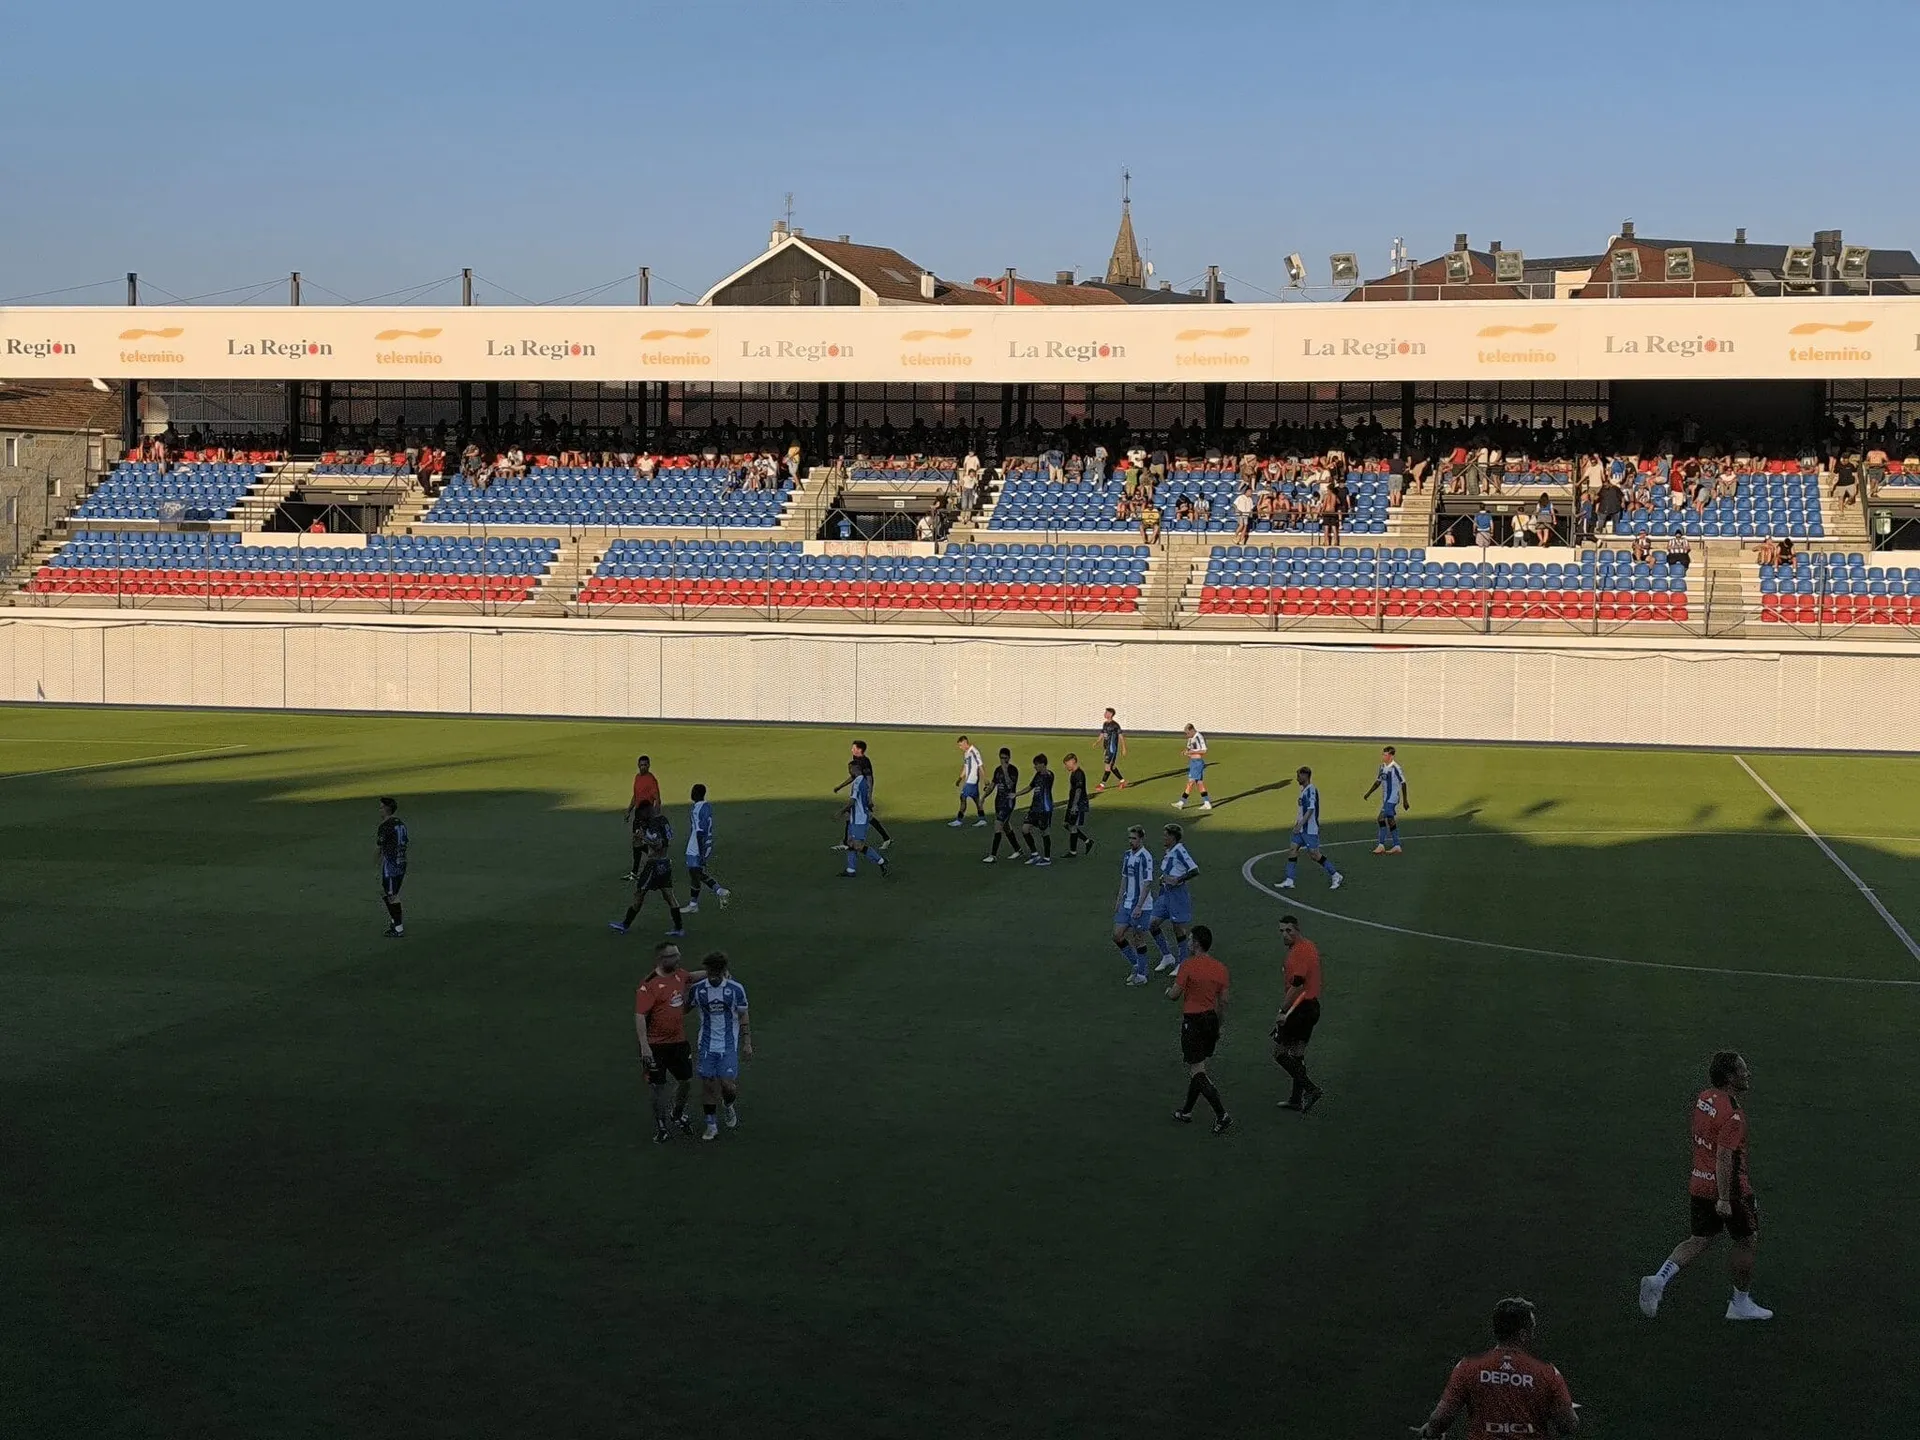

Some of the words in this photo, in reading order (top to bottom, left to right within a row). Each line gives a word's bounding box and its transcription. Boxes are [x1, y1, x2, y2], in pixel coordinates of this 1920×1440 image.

[6, 338, 76, 359] Región
[119, 347, 185, 364] telemiño
[227, 338, 255, 356] La
[260, 338, 333, 360] Región
[486, 339, 516, 357] La
[521, 339, 596, 361] Región
[741, 340, 772, 359] La
[776, 340, 854, 362] Región
[1008, 340, 1039, 359] La
[1044, 340, 1126, 363] Región
[1303, 338, 1336, 357] La
[1341, 337, 1427, 361] Región
[1477, 348, 1557, 365] telemiño
[1604, 335, 1639, 354] La
[1644, 334, 1735, 361] Región
[1788, 346, 1873, 362] telemiño
[375, 350, 443, 365] telemiño
[641, 351, 712, 366] telemiño
[900, 352, 973, 369] telemiño
[1480, 1370, 1534, 1388] DEPOR
